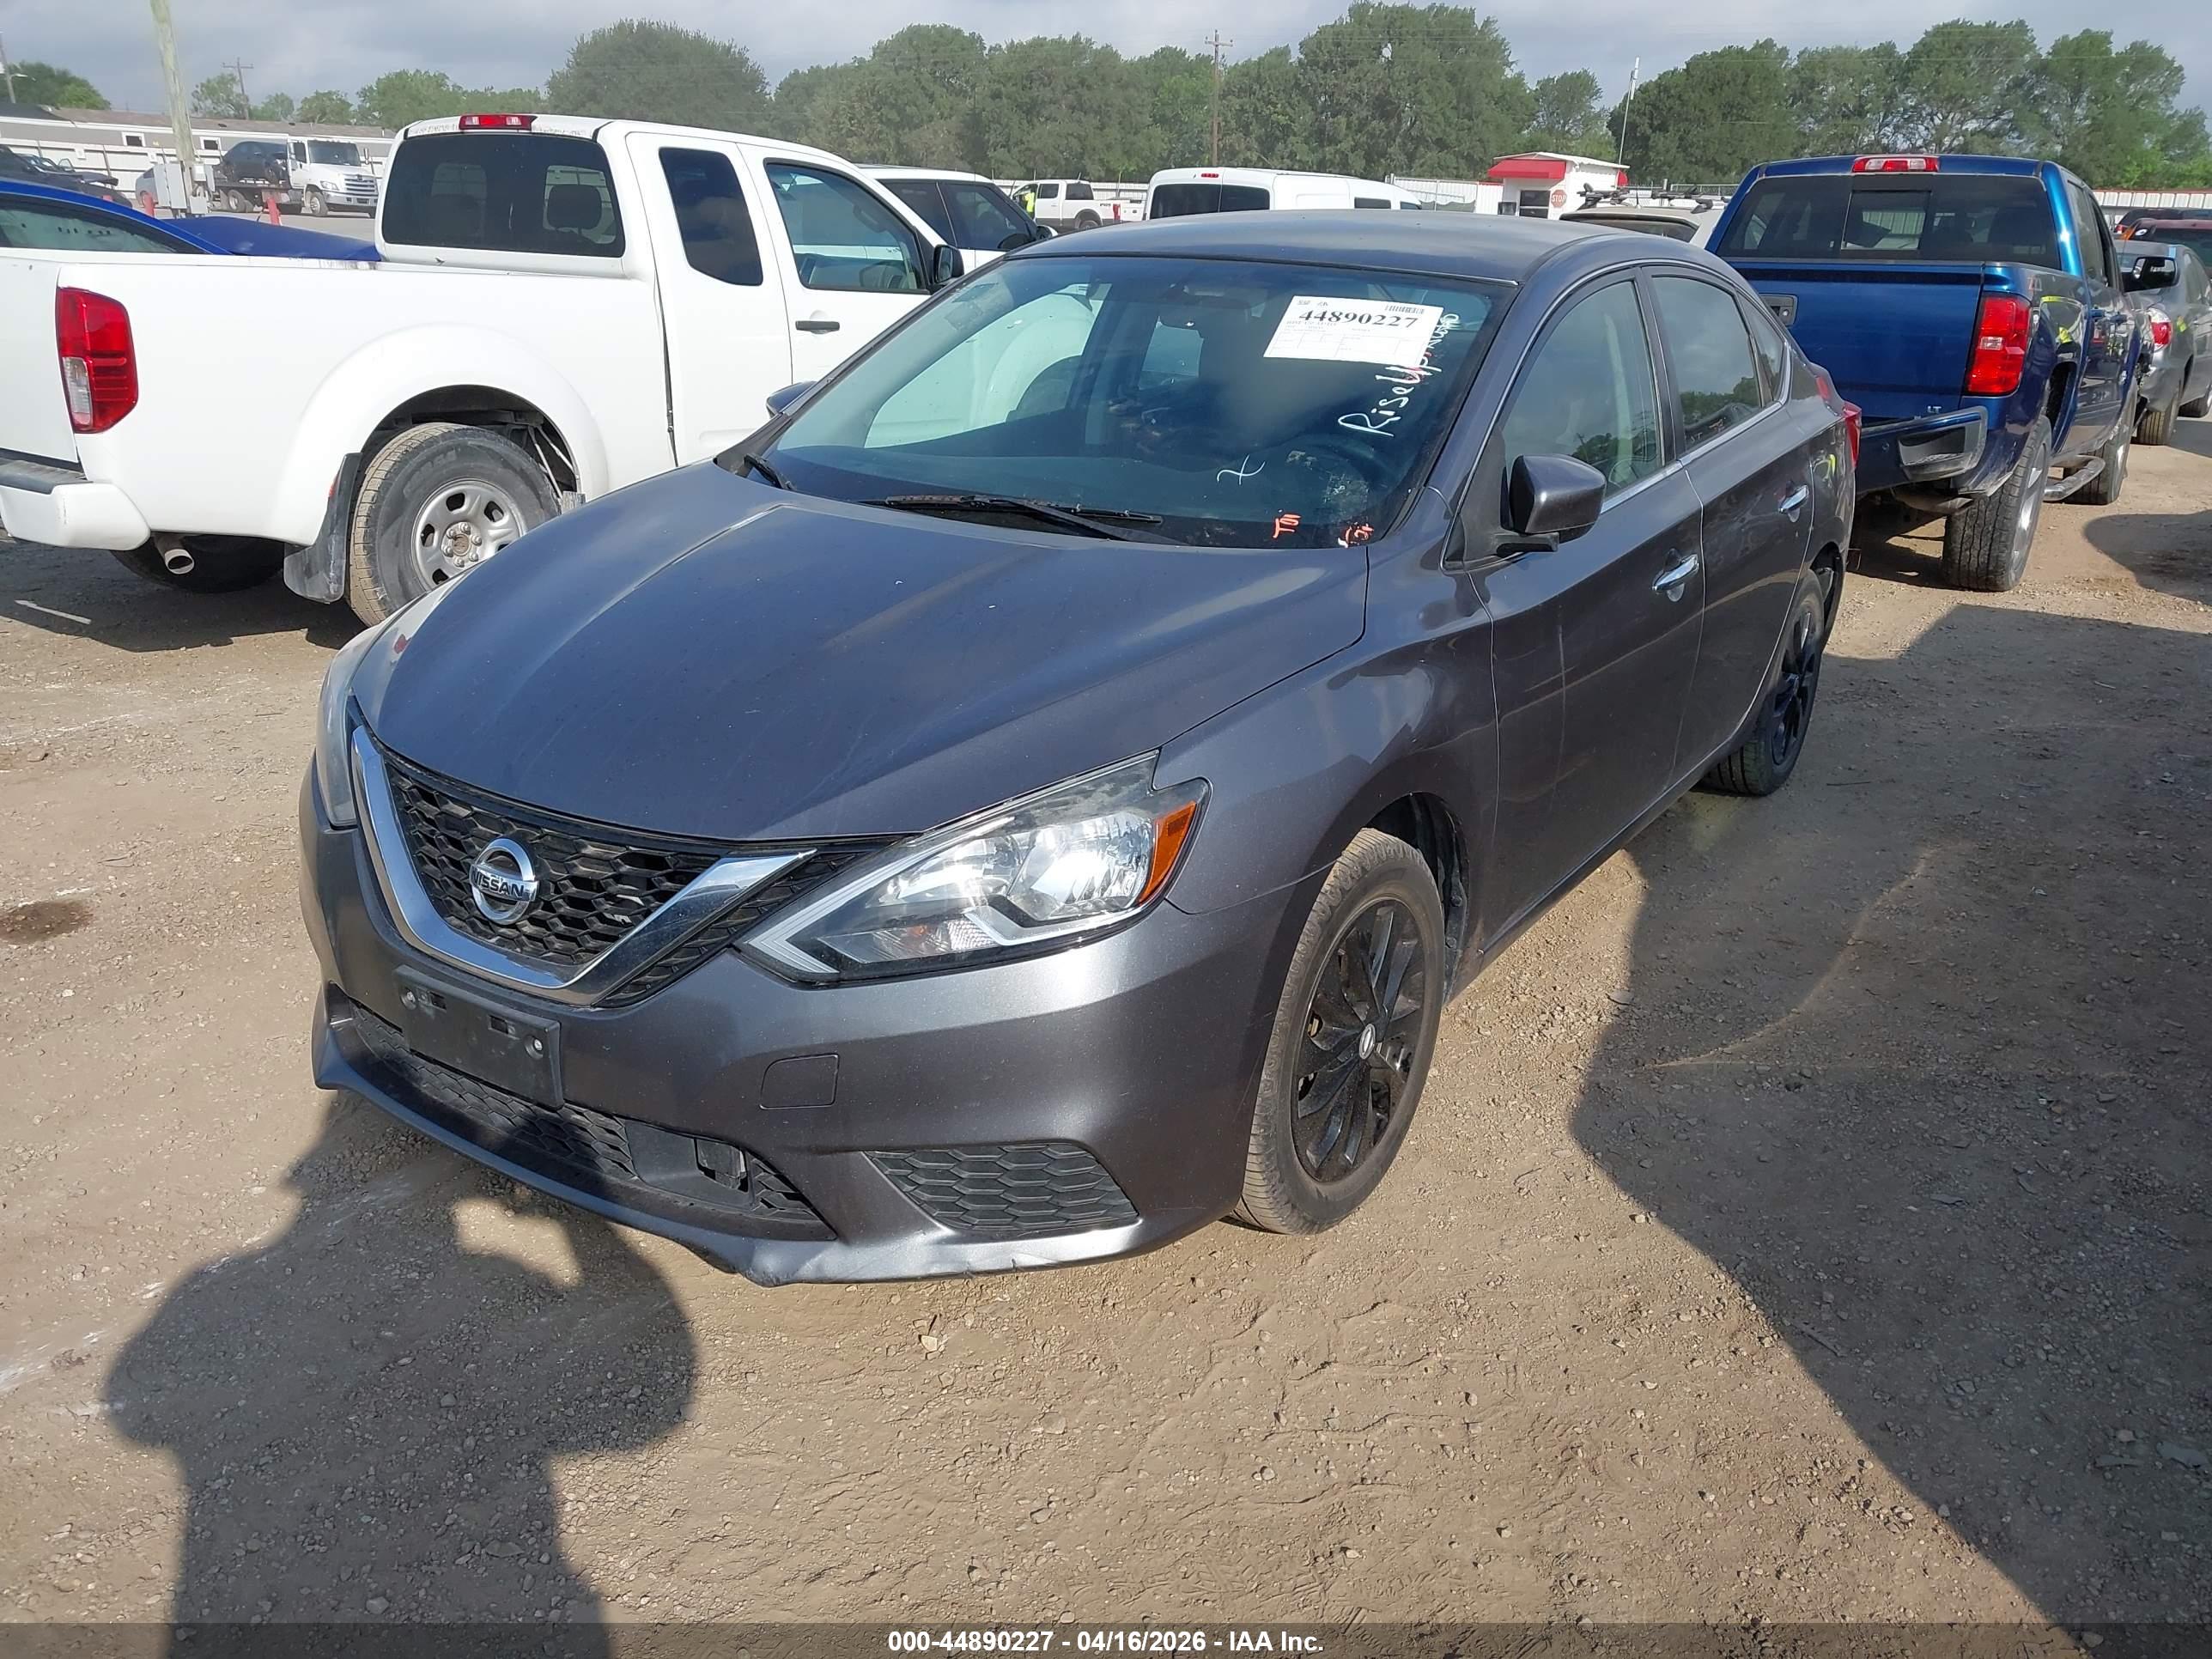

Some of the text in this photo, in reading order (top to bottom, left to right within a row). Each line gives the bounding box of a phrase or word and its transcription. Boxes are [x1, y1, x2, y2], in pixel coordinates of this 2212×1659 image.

[1552, 194, 1565, 203] STOP
[1298, 309, 1419, 328] 44890227
[1927, 405, 1942, 414] LT
[472, 869, 525, 897] NISSAN
